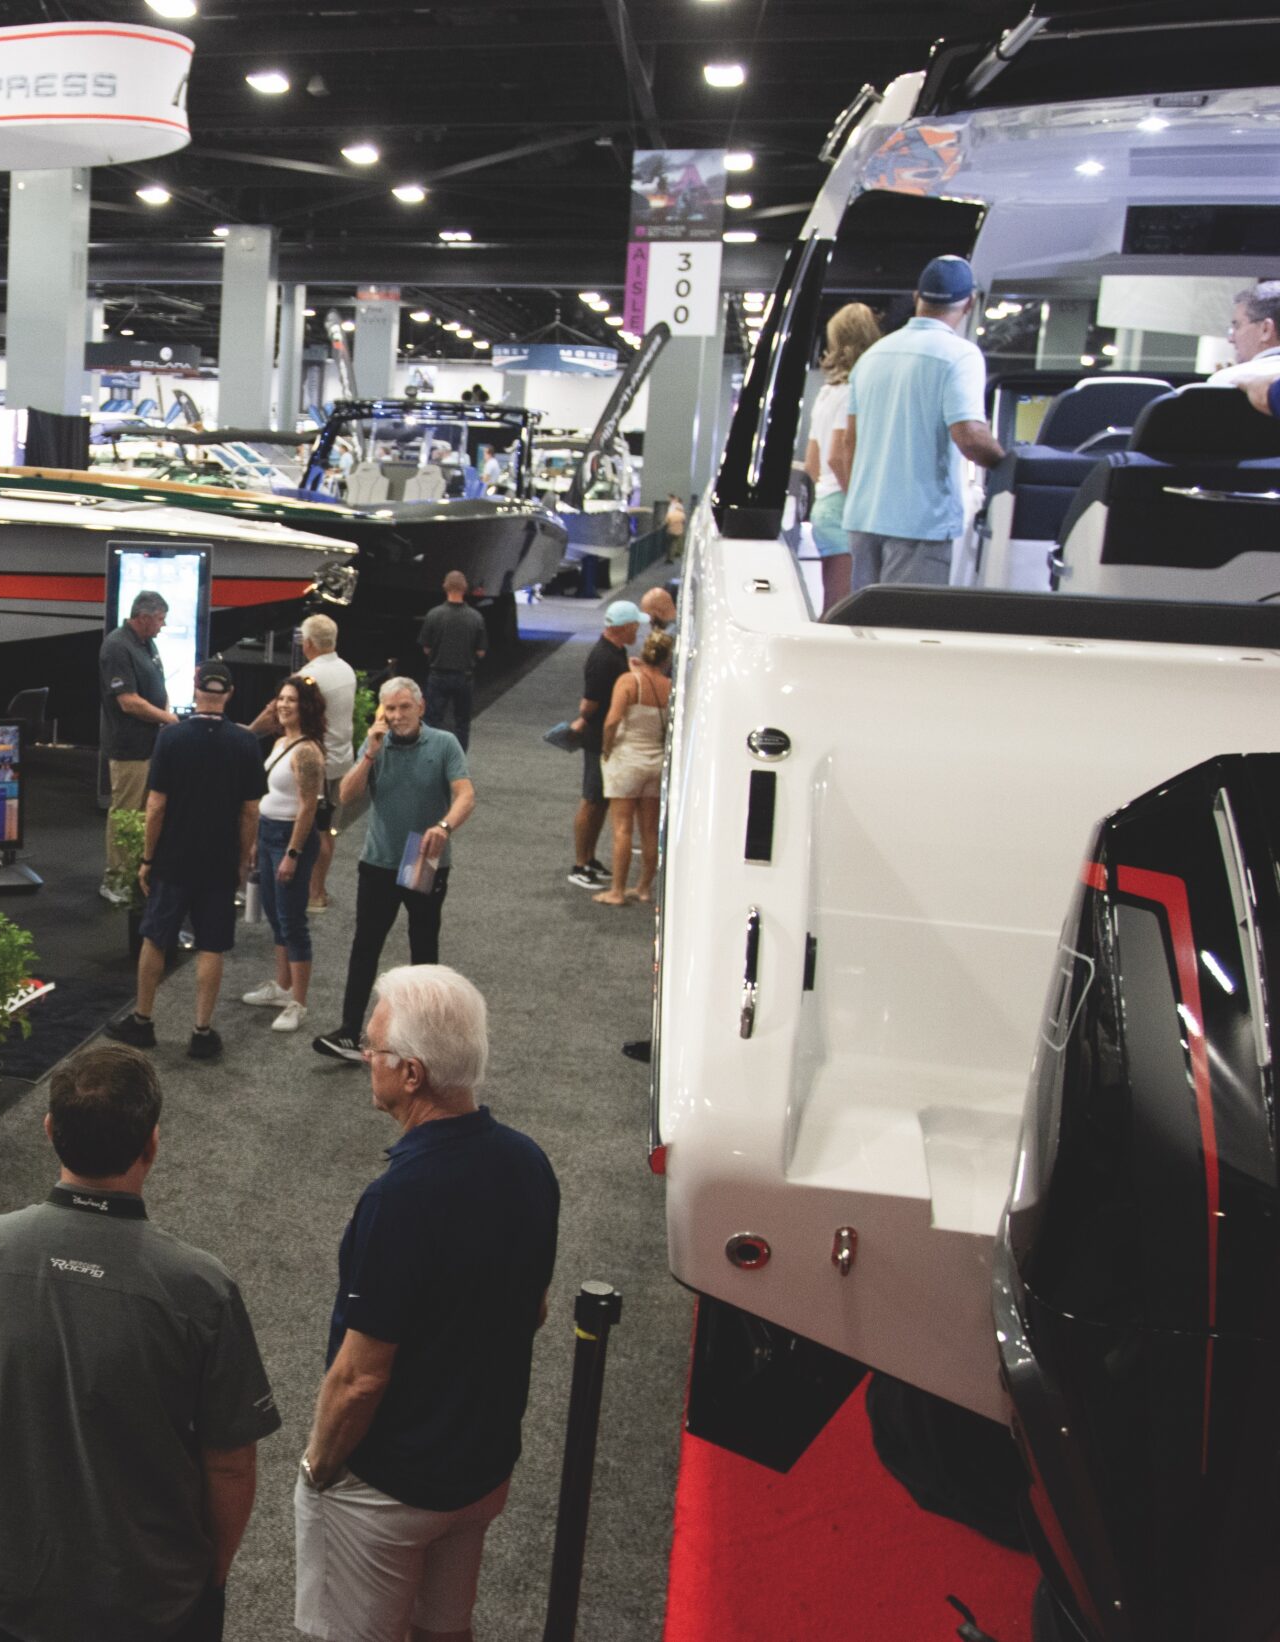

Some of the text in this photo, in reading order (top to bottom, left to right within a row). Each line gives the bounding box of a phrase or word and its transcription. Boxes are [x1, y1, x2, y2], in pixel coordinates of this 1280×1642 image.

[629, 248, 646, 329] AISLE
[672, 252, 693, 325] 300
[51, 1258, 105, 1279] Racing
